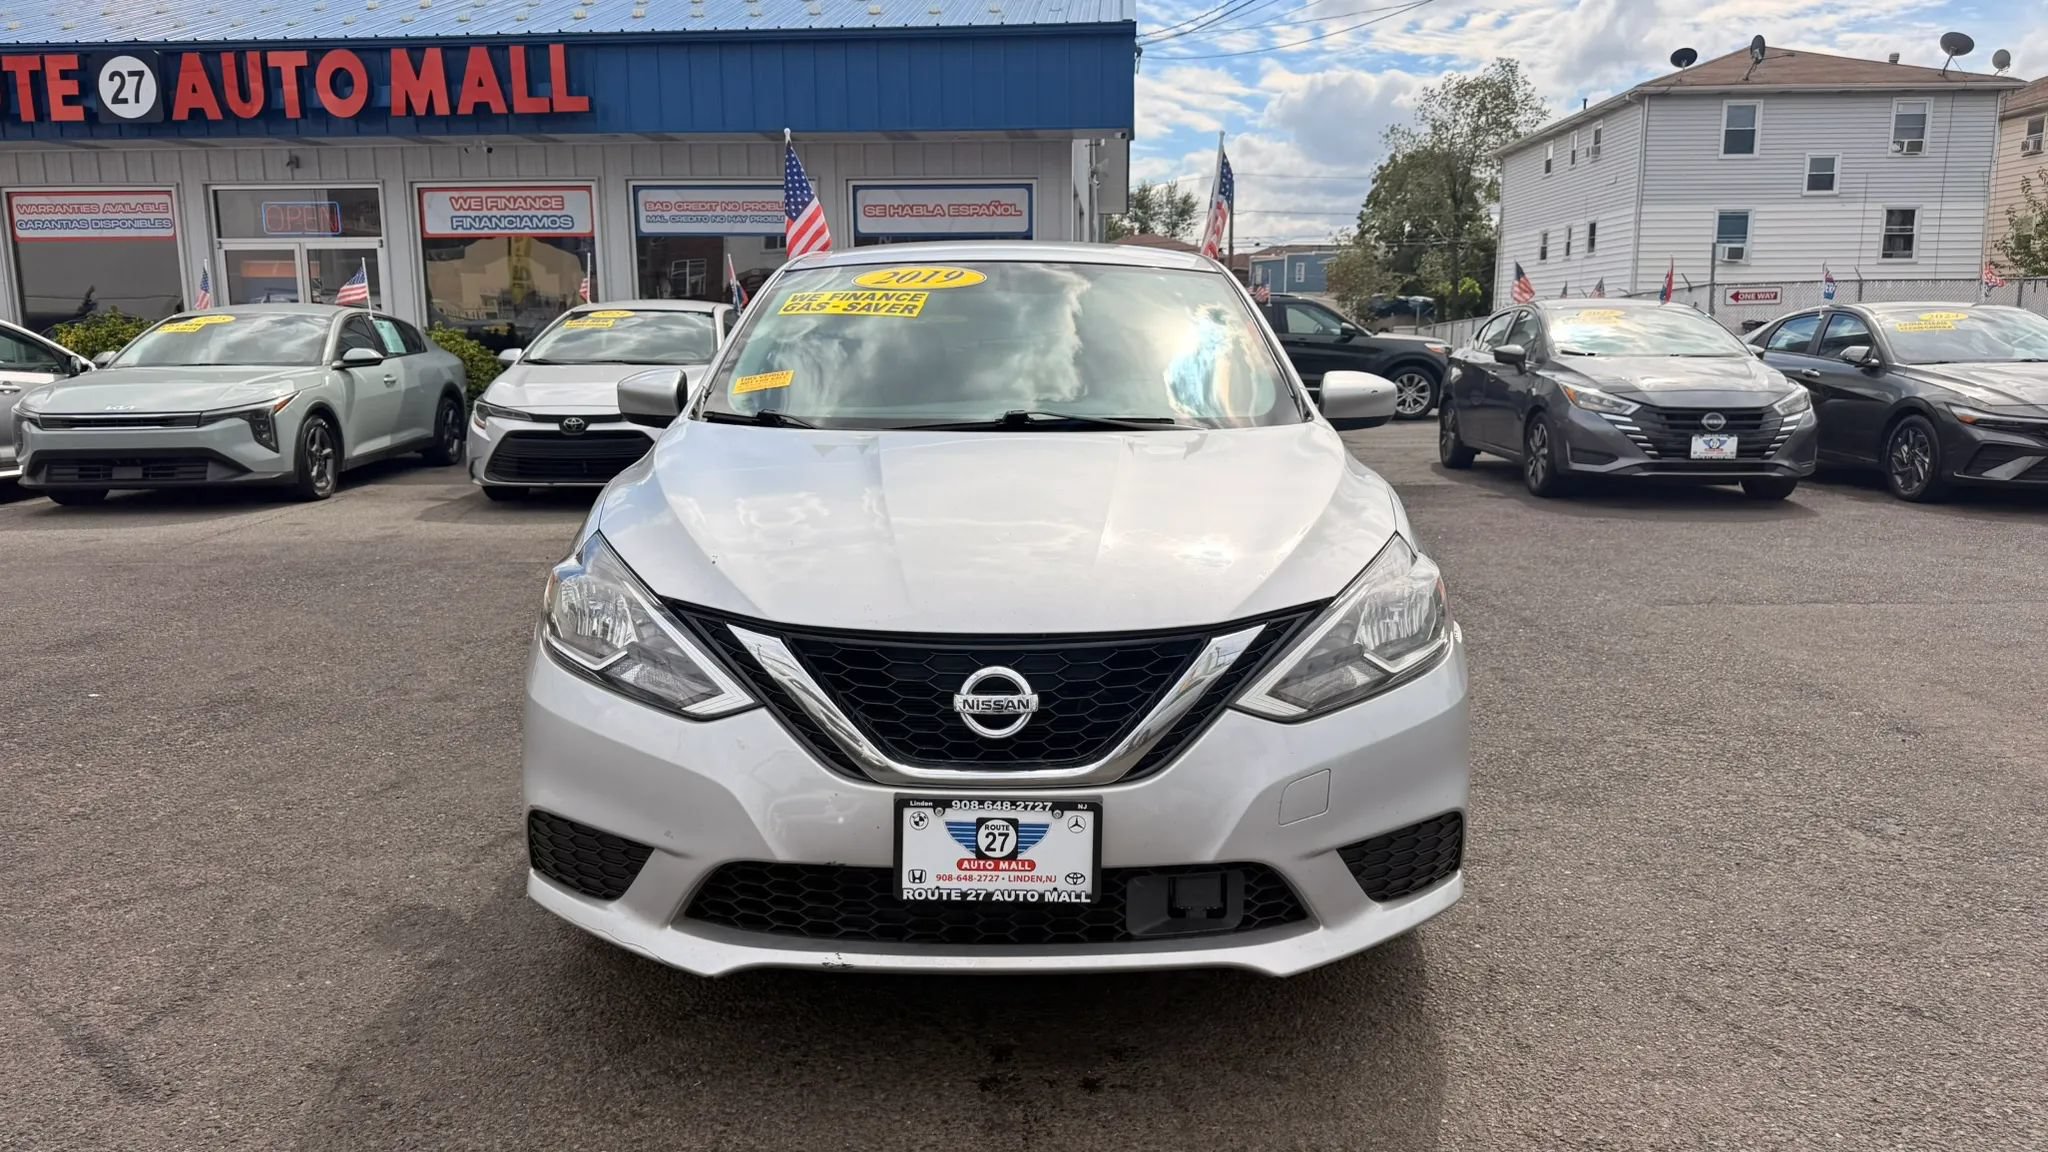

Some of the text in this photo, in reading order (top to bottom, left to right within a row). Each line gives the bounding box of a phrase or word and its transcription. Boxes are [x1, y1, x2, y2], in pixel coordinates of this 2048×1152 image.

[108, 70, 145, 104] 27
[172, 49, 369, 121] AUTO
[390, 43, 590, 117] MALL
[16, 203, 169, 215] WARRANTIES AVAILABLE
[450, 195, 564, 211] WE FINANCE
[645, 201, 784, 212] BAD CREDIT NO PROBL
[864, 200, 1022, 218] SE HABLA ESPAÑOL
[16, 218, 173, 230] GARANTIAS DISPONIBLES
[266, 205, 338, 232] OPEN
[451, 215, 574, 230] FINANCIAMOS
[645, 214, 785, 224] MAL CREDITO NO HAY PROBL
[872, 270, 965, 285] 2019
[789, 292, 925, 303] WE FINANCE
[1738, 291, 1776, 300] ONE WAY
[782, 302, 827, 313] GAS
[842, 302, 920, 315] SAVER
[962, 699, 1030, 711] NISSAN
[951, 800, 1052, 812] 908-648-2727
[984, 832, 1010, 852] 27
[962, 860, 1031, 870] AUTO MALL
[936, 874, 1057, 884] 908-648-2727 LINDEN,NJ
[902, 888, 1091, 903] ROUTE 27 AUTO MALL
